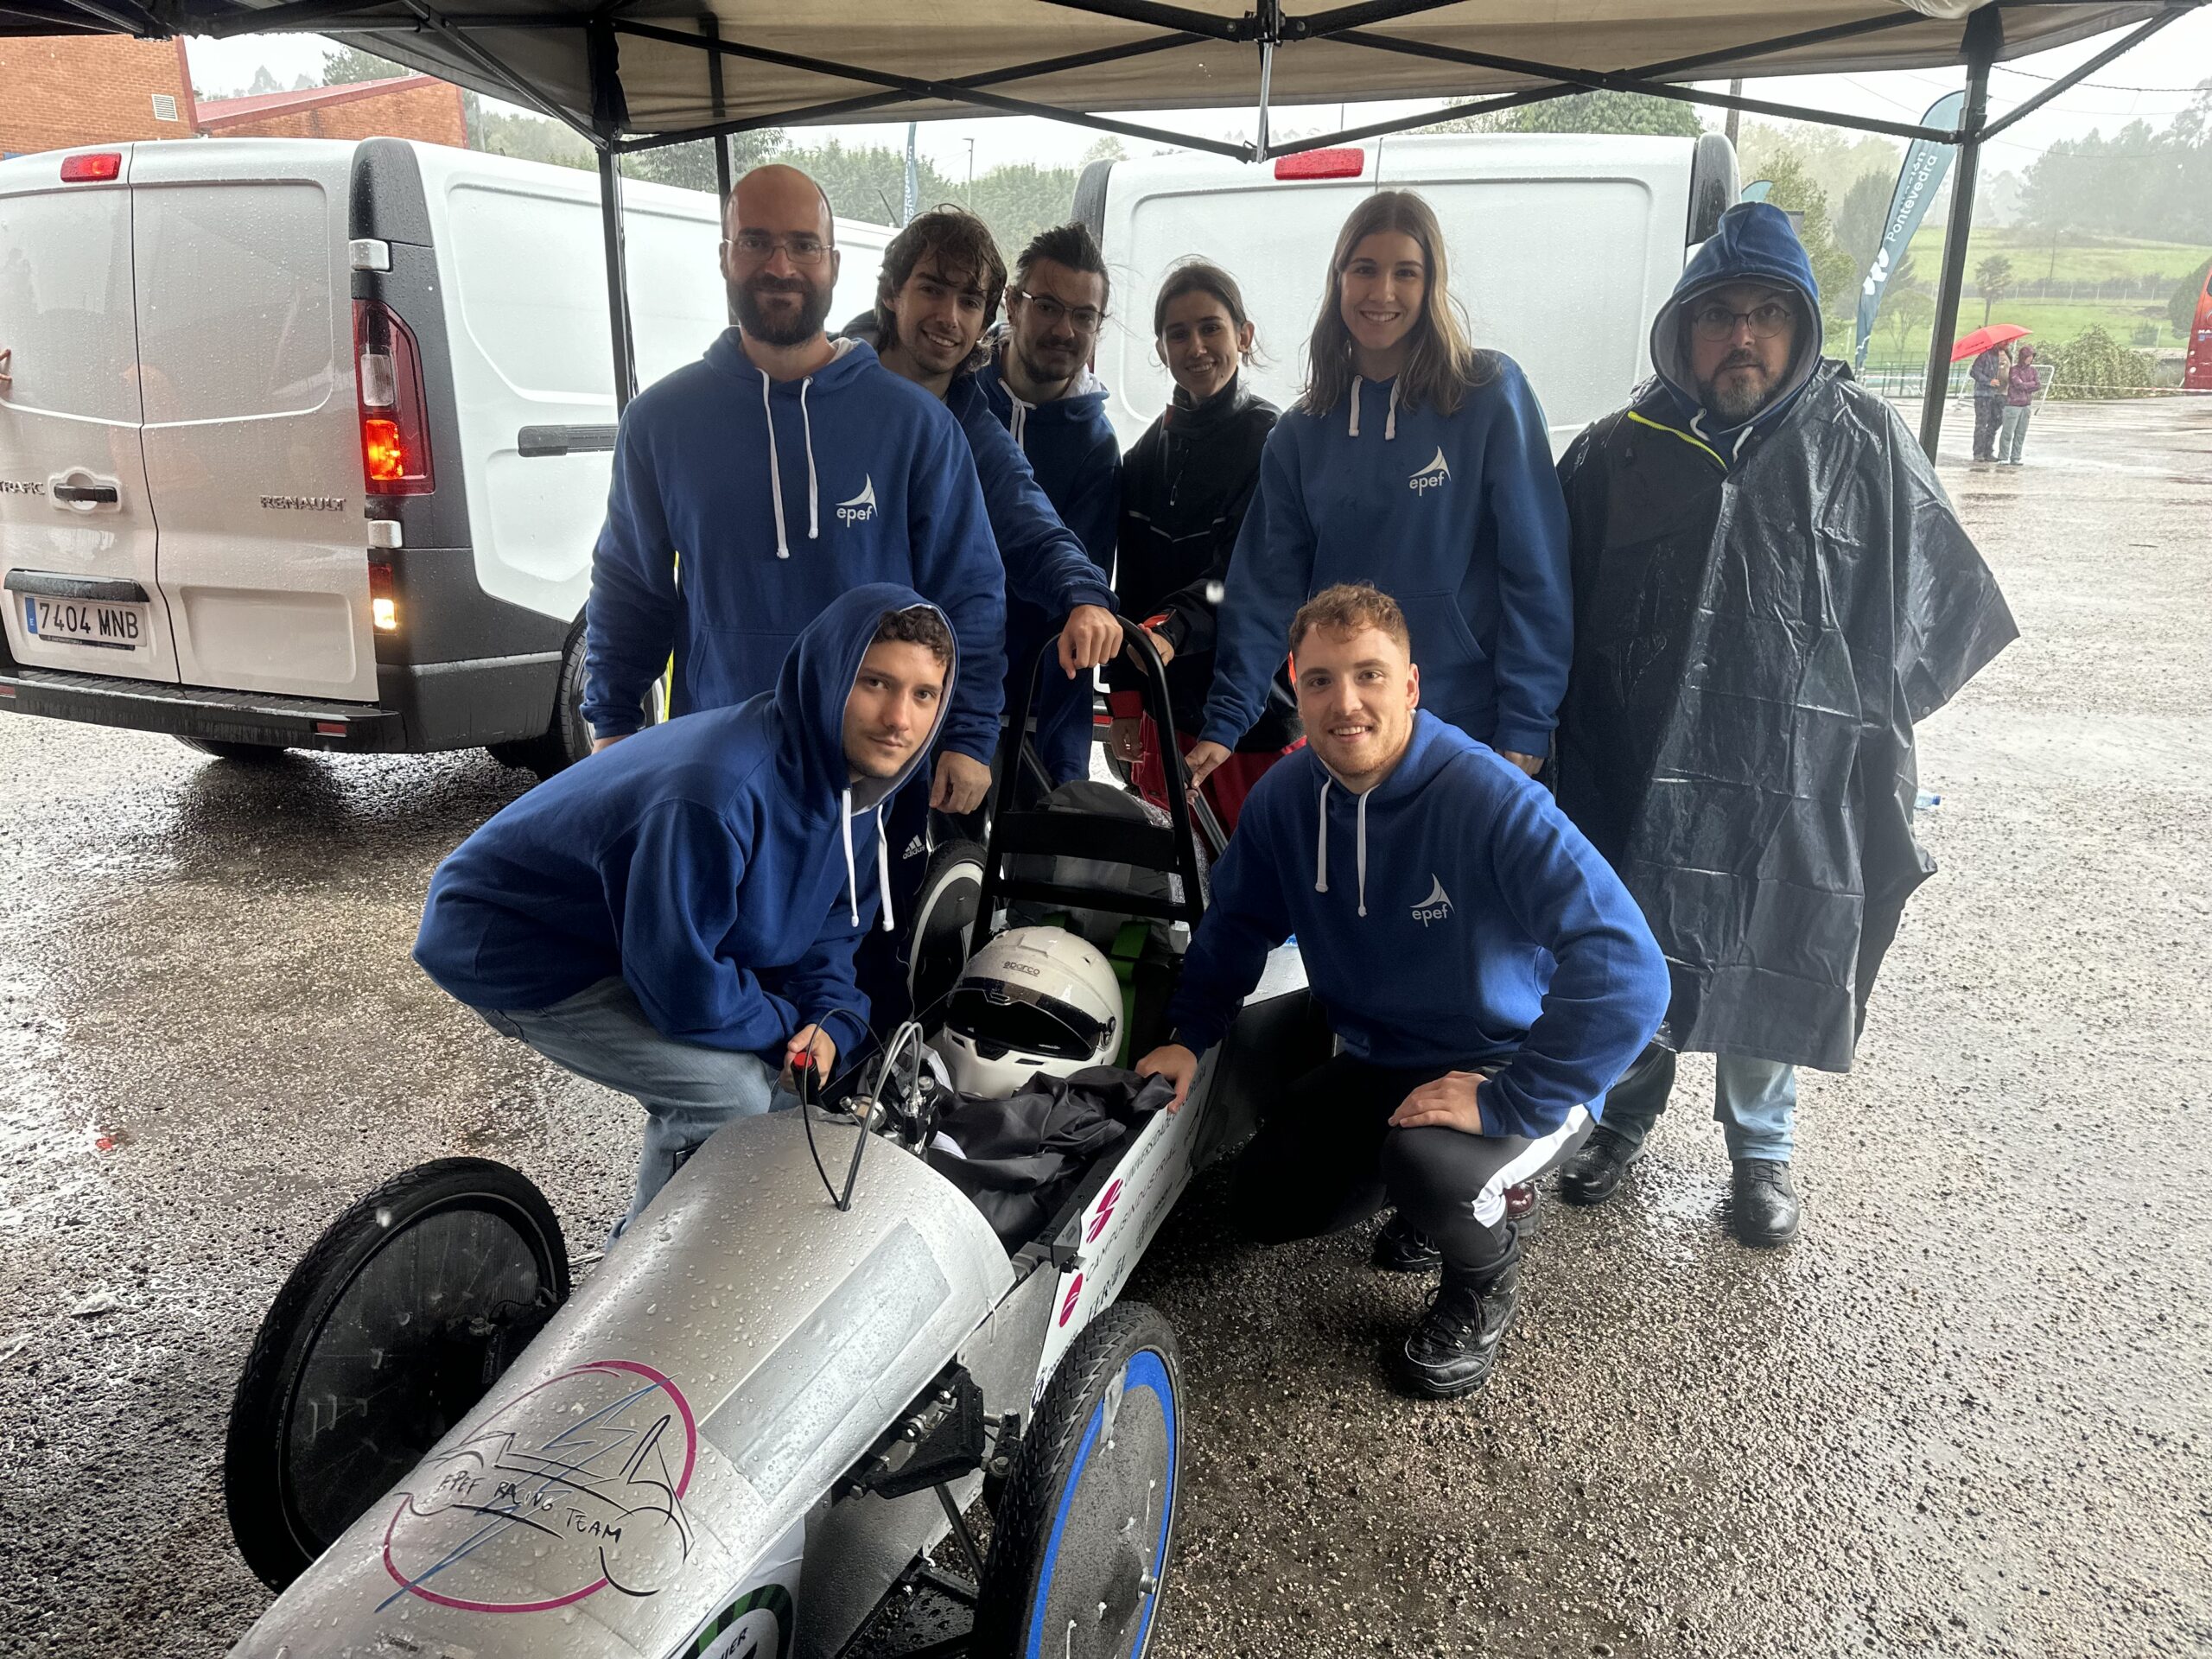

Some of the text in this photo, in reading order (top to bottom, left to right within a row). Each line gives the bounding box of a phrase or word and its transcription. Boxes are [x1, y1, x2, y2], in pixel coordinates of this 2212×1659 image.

[1886, 155, 1938, 242] Pontevedra
[0, 481, 45, 495] TRAFIC
[1409, 471, 1445, 497] epef
[260, 495, 346, 512] RENAULT
[836, 505, 873, 528] epef
[39, 603, 92, 634] 7404
[98, 608, 139, 639] MNB
[1412, 904, 1448, 927] epef
[494, 1481, 553, 1511] RACING
[567, 1507, 622, 1543] TEAM
